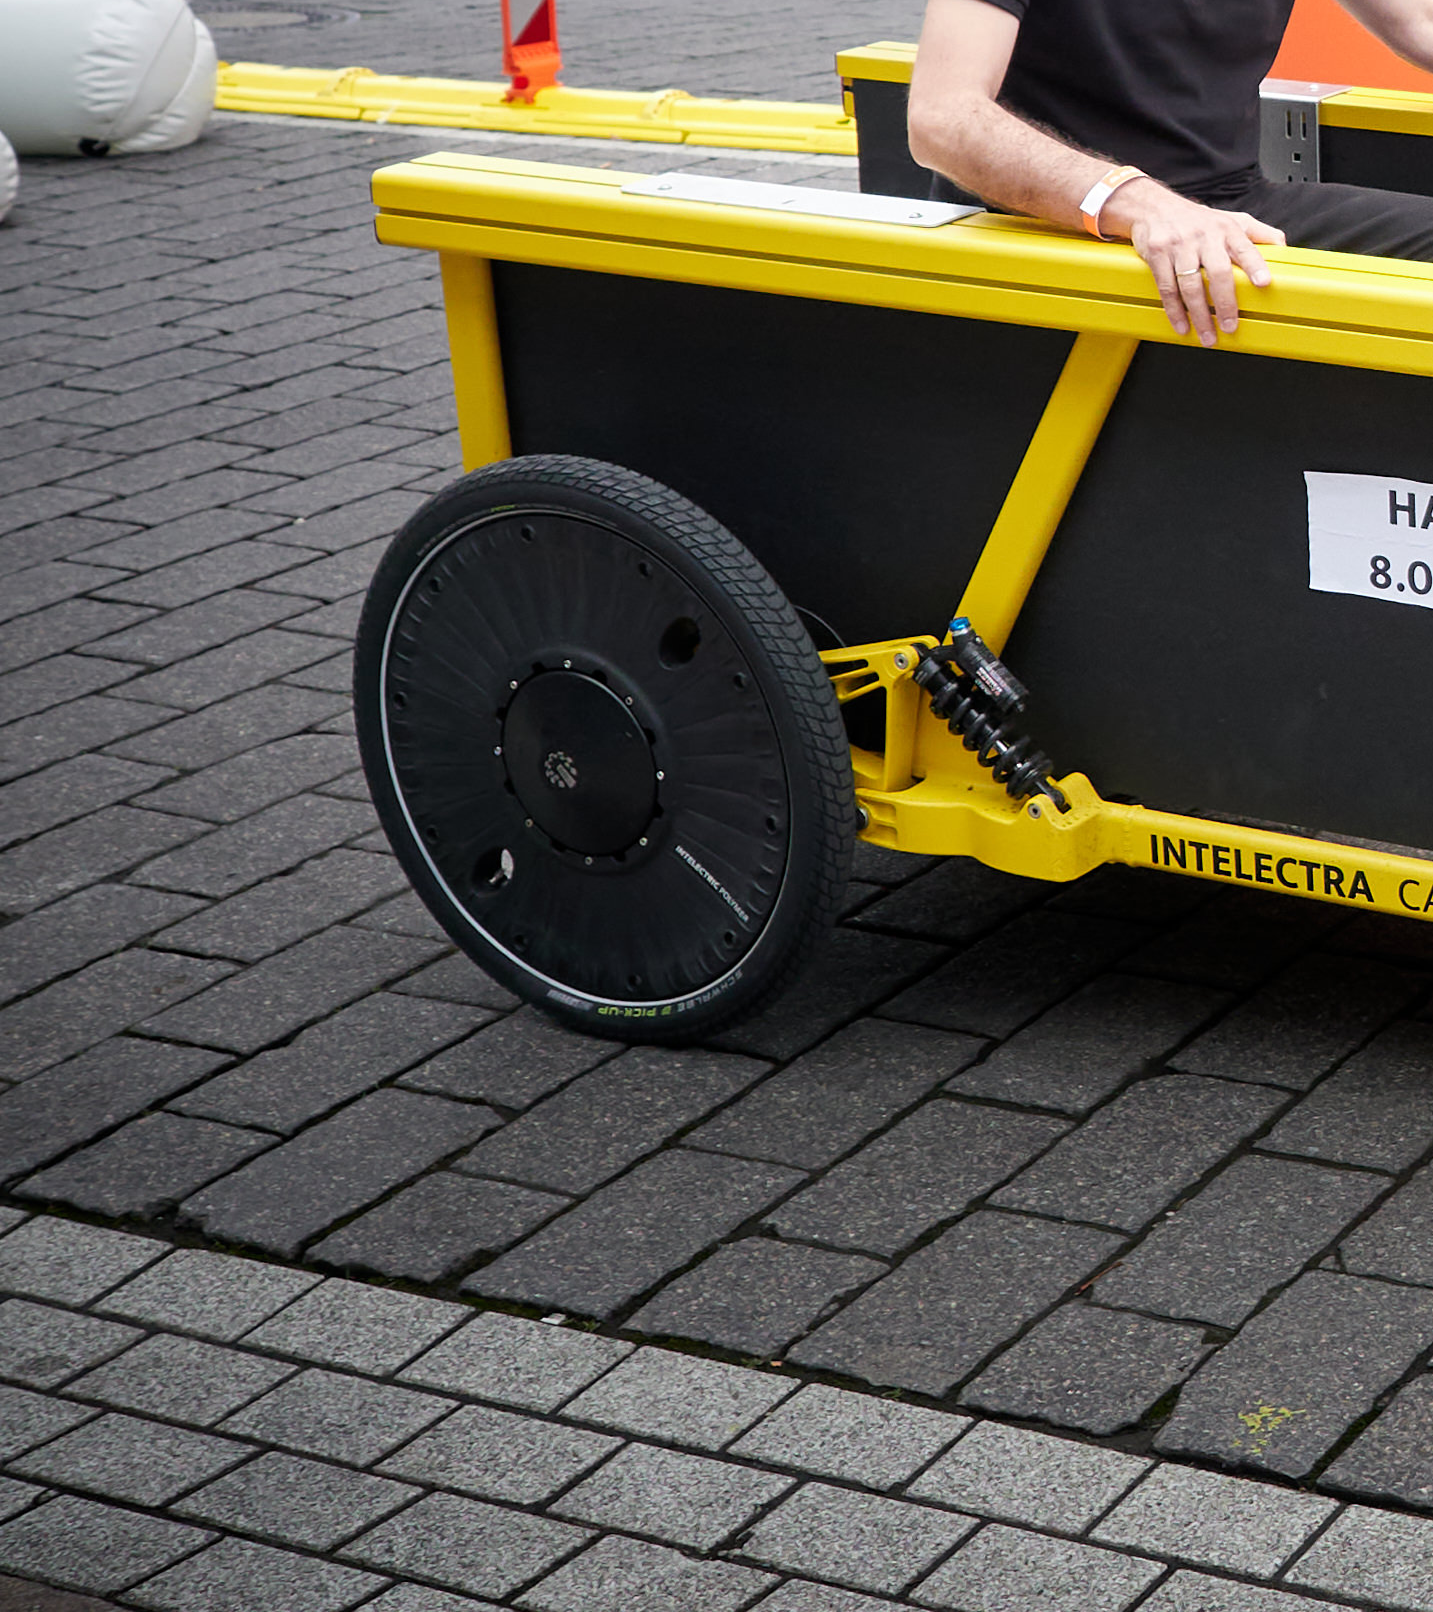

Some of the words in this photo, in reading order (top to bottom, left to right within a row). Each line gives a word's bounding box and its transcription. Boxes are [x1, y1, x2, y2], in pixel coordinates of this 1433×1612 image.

[1369, 555, 1433, 595] 8.0
[1150, 833, 1375, 903] INTELECTRA
[597, 1007, 657, 1017] PICK-UP
